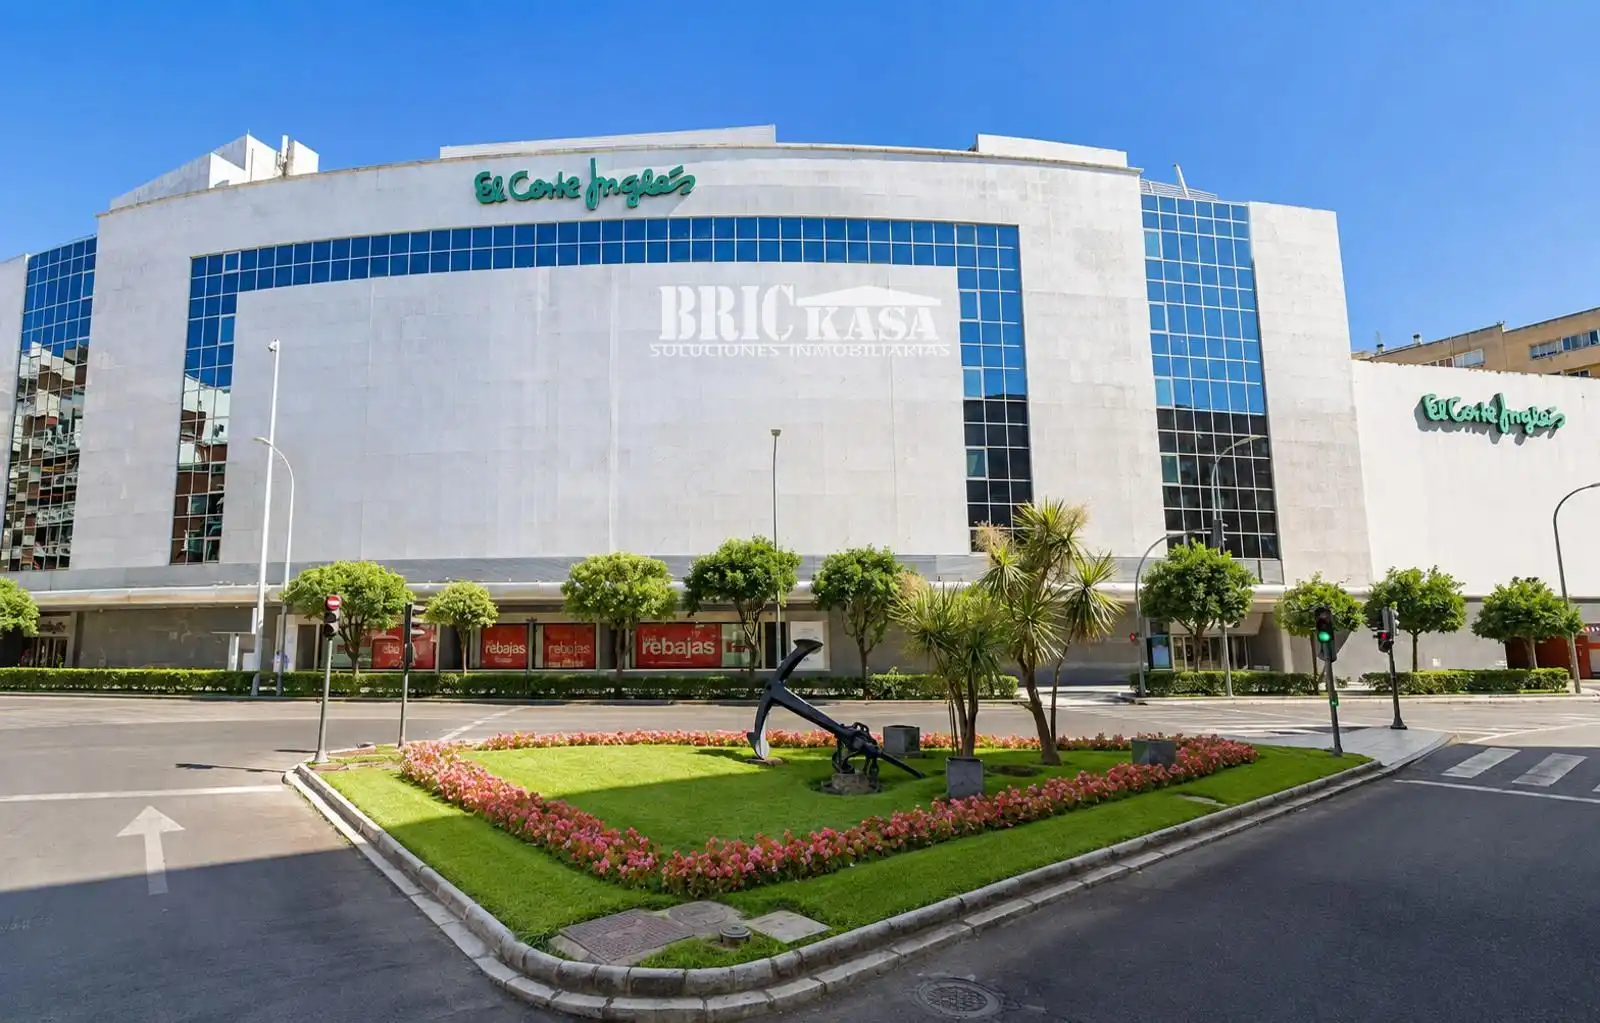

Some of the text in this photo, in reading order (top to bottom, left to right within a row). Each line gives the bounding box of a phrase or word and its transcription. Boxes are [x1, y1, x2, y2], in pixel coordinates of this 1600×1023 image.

[474, 157, 696, 211] El Corte Inglés
[1421, 392, 1566, 434] El Corte Inglés
[485, 641, 526, 657] rebajas
[548, 641, 590, 656] rebajas
[641, 637, 715, 658] rebajas
